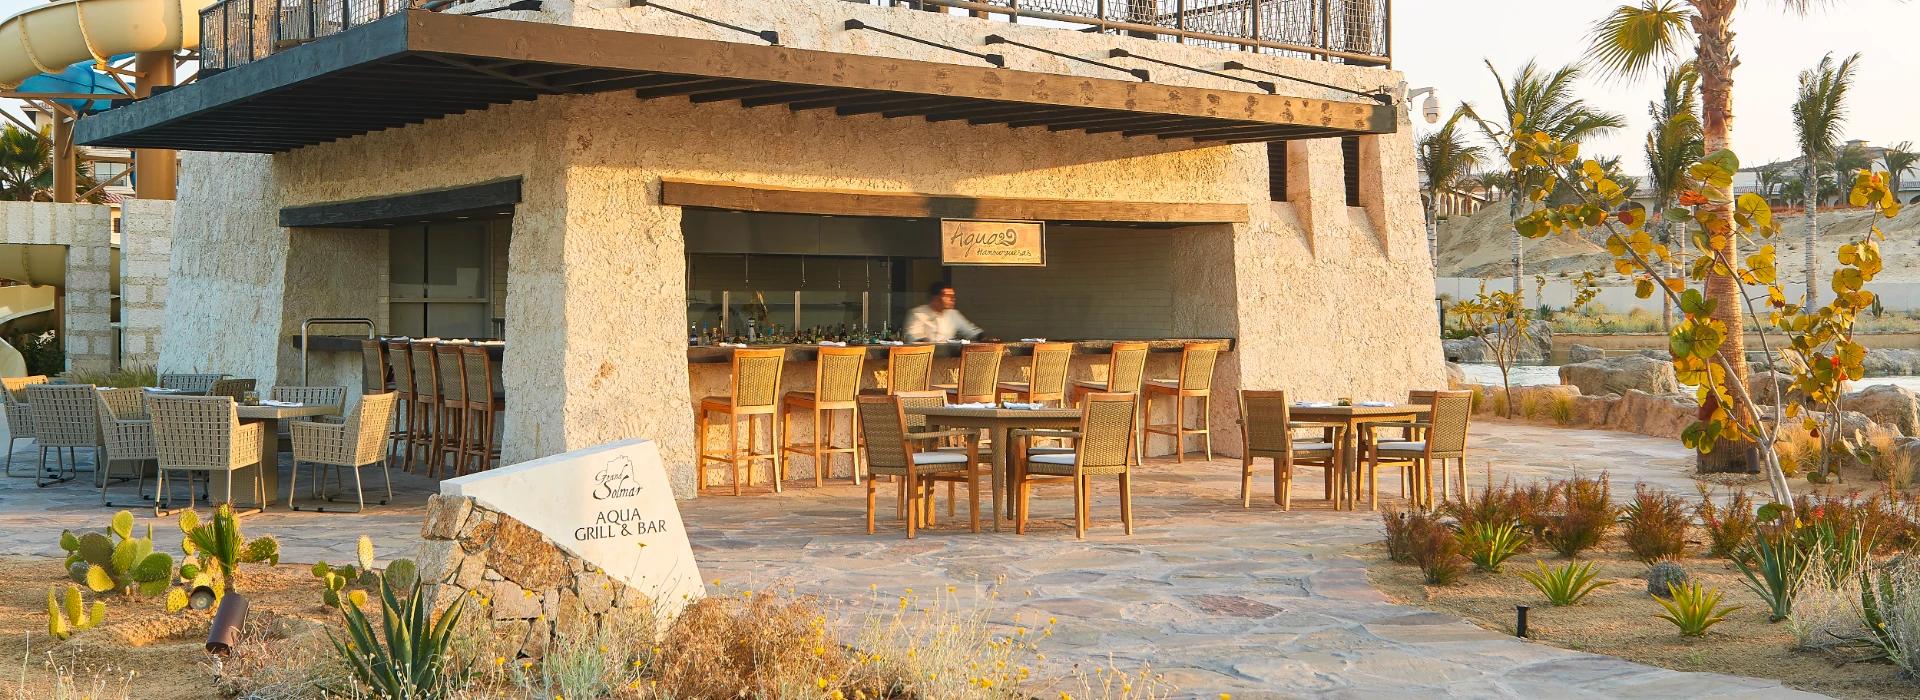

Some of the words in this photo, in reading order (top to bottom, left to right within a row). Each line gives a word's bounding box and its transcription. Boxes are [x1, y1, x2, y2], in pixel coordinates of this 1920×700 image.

[594, 466, 627, 485] Grand
[592, 475, 643, 500] Solmar
[596, 508, 641, 525] AQUA
[574, 525, 616, 541] GRILL
[621, 524, 632, 536] &
[638, 520, 667, 534] BAR
